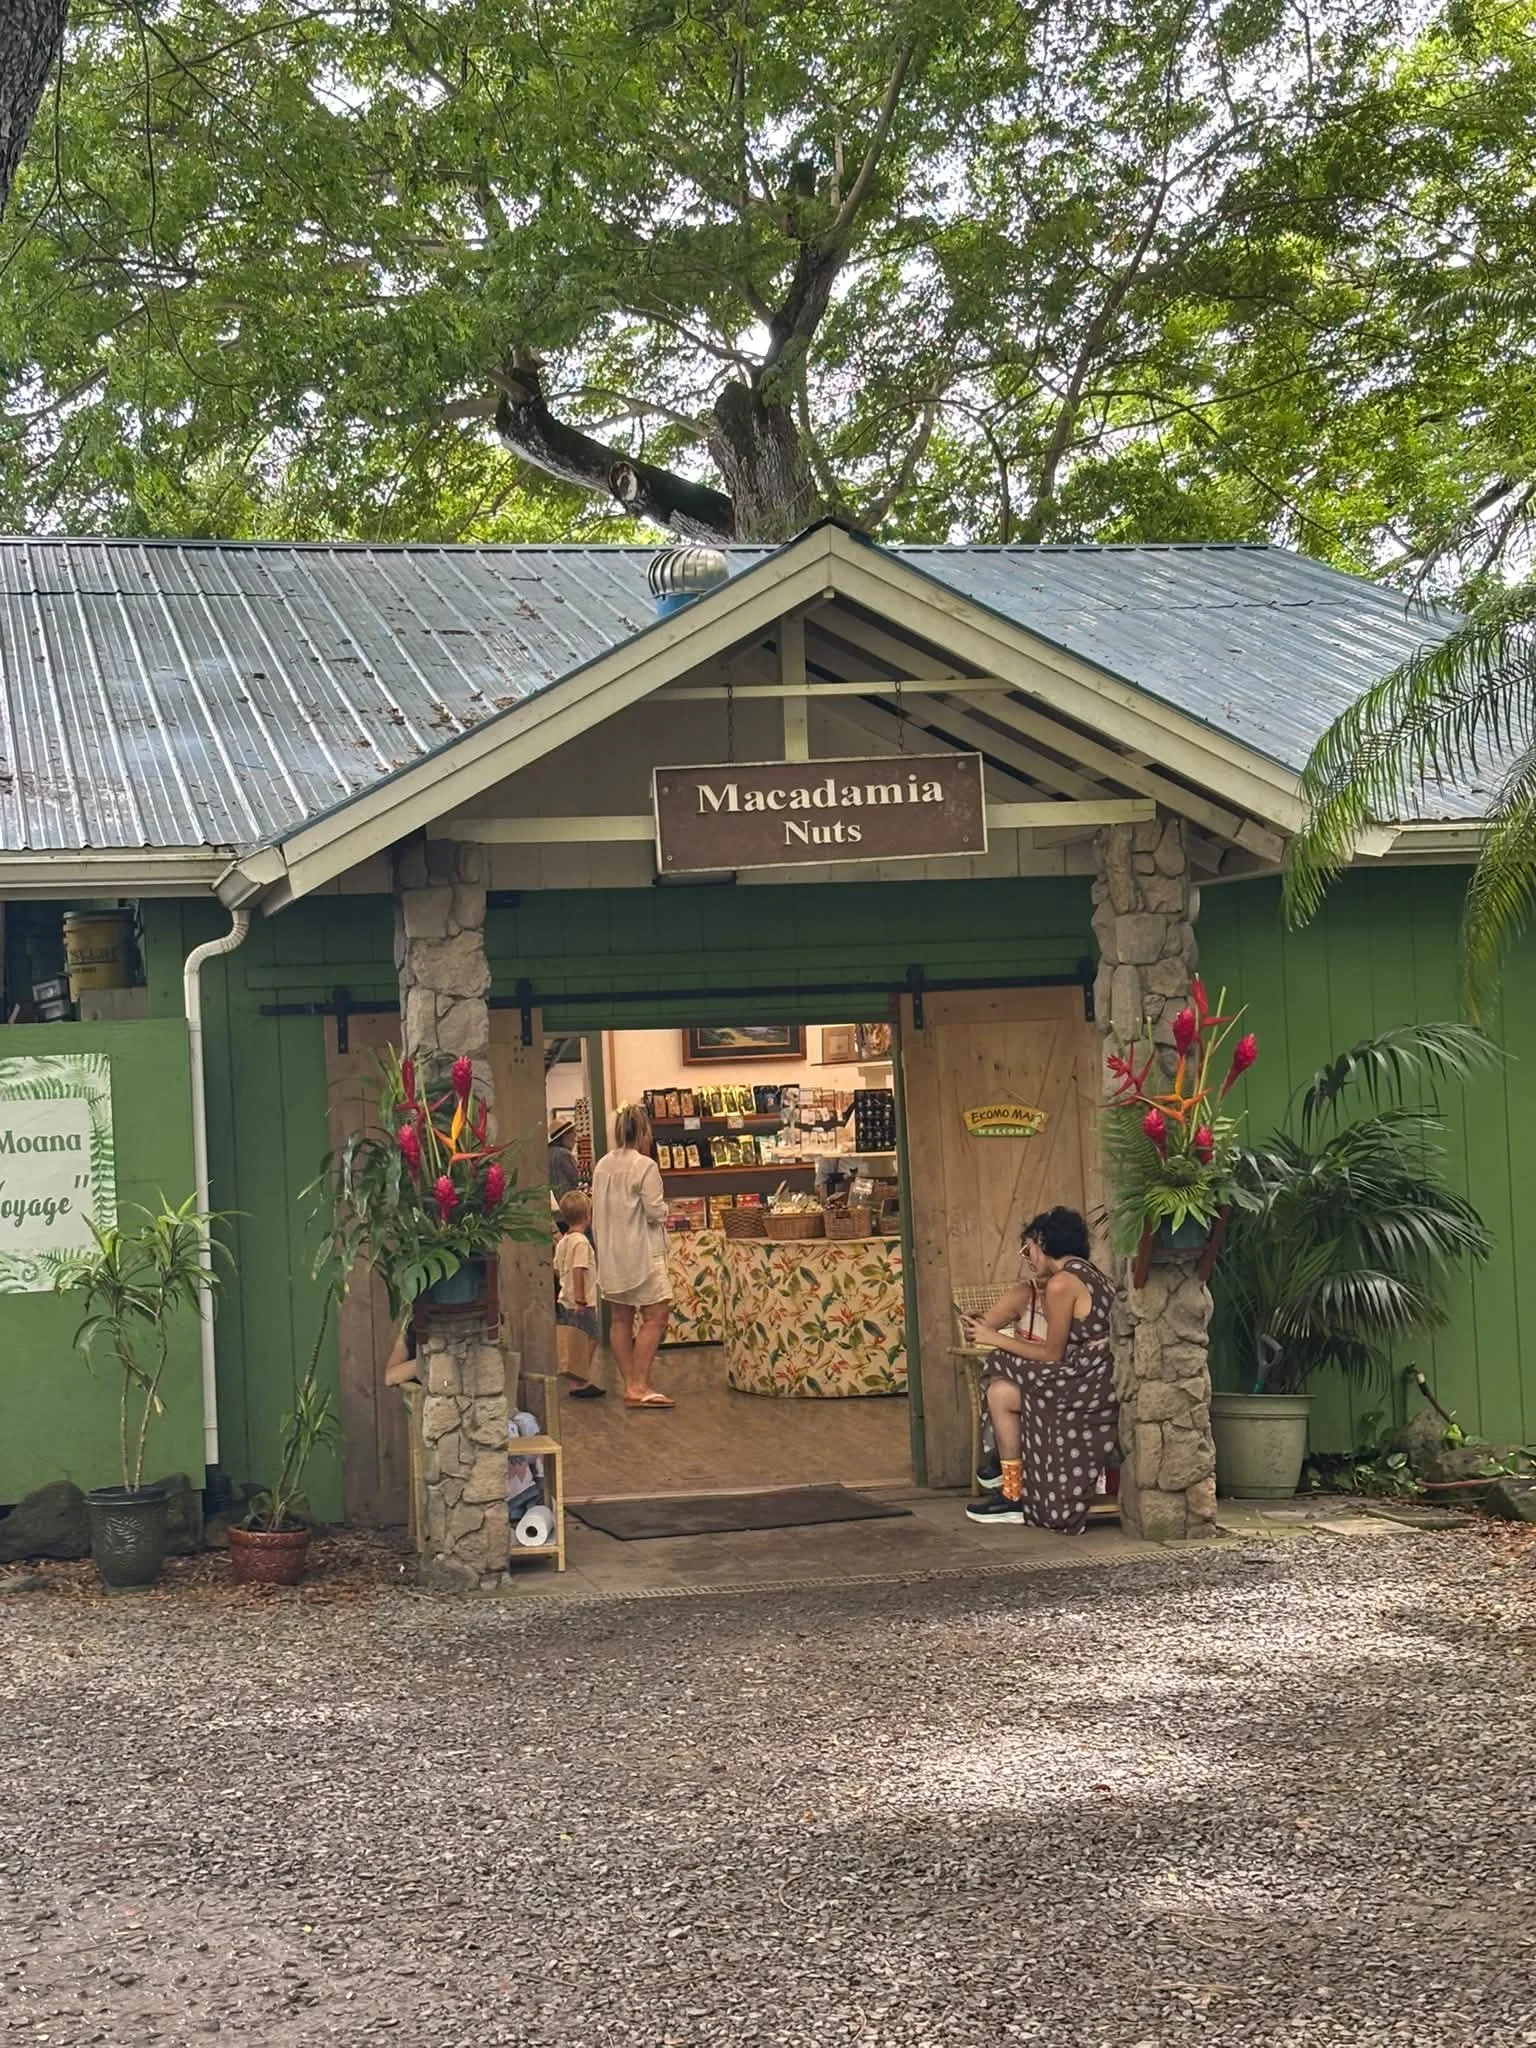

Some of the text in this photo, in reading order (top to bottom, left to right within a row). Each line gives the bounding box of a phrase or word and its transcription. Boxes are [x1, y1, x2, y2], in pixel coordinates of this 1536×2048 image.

[696, 774, 944, 814] Macadamia
[783, 820, 862, 847] Nuts
[0, 1174, 89, 1227] oyage"
